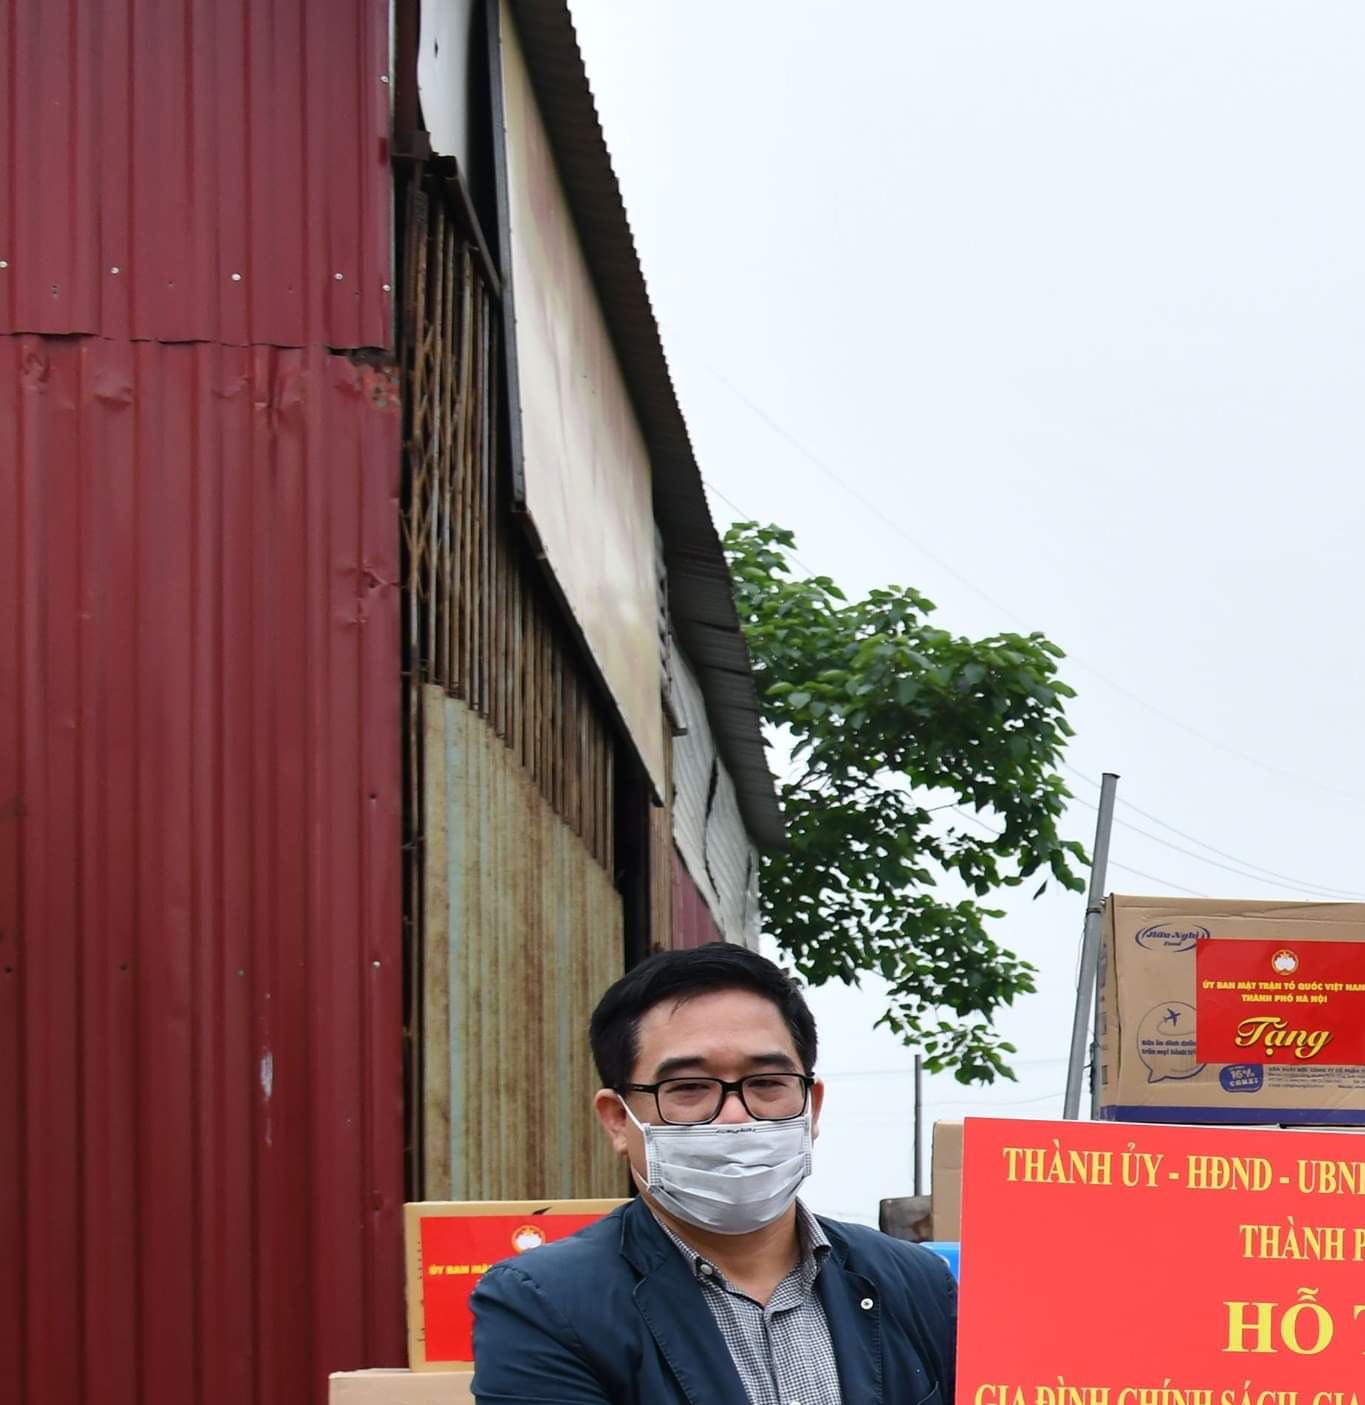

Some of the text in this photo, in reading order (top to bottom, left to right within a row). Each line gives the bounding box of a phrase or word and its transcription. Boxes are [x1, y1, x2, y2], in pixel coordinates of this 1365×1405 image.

[1234, 1016, 1330, 1059] Tặng
[1003, 1139, 1113, 1185] THÀNH
[1121, 1142, 1164, 1187] ỦY
[1186, 1155, 1272, 1191] HĐND
[1239, 1216, 1345, 1261] THÀNH
[1222, 1287, 1333, 1354] HỖ
